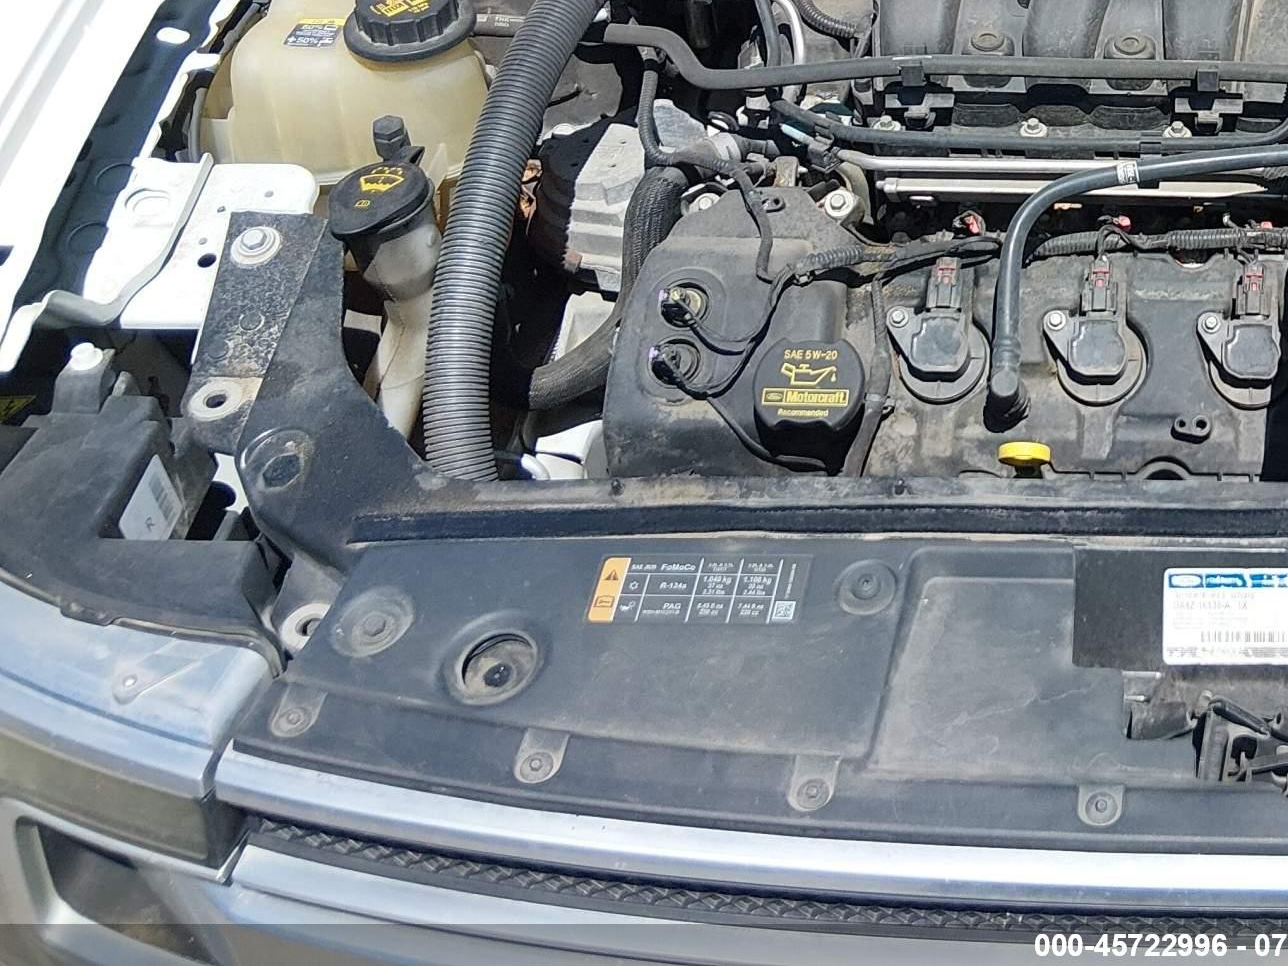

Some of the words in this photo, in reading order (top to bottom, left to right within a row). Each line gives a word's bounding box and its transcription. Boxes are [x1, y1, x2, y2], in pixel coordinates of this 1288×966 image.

[784, 349, 804, 360] SAE
[805, 350, 838, 361] 5W-20
[786, 390, 847, 404] Motorcraft
[777, 408, 829, 418] Recommended
[660, 563, 697, 572] FoMoCo
[659, 581, 688, 590] R-134a
[662, 602, 682, 610] PAG
